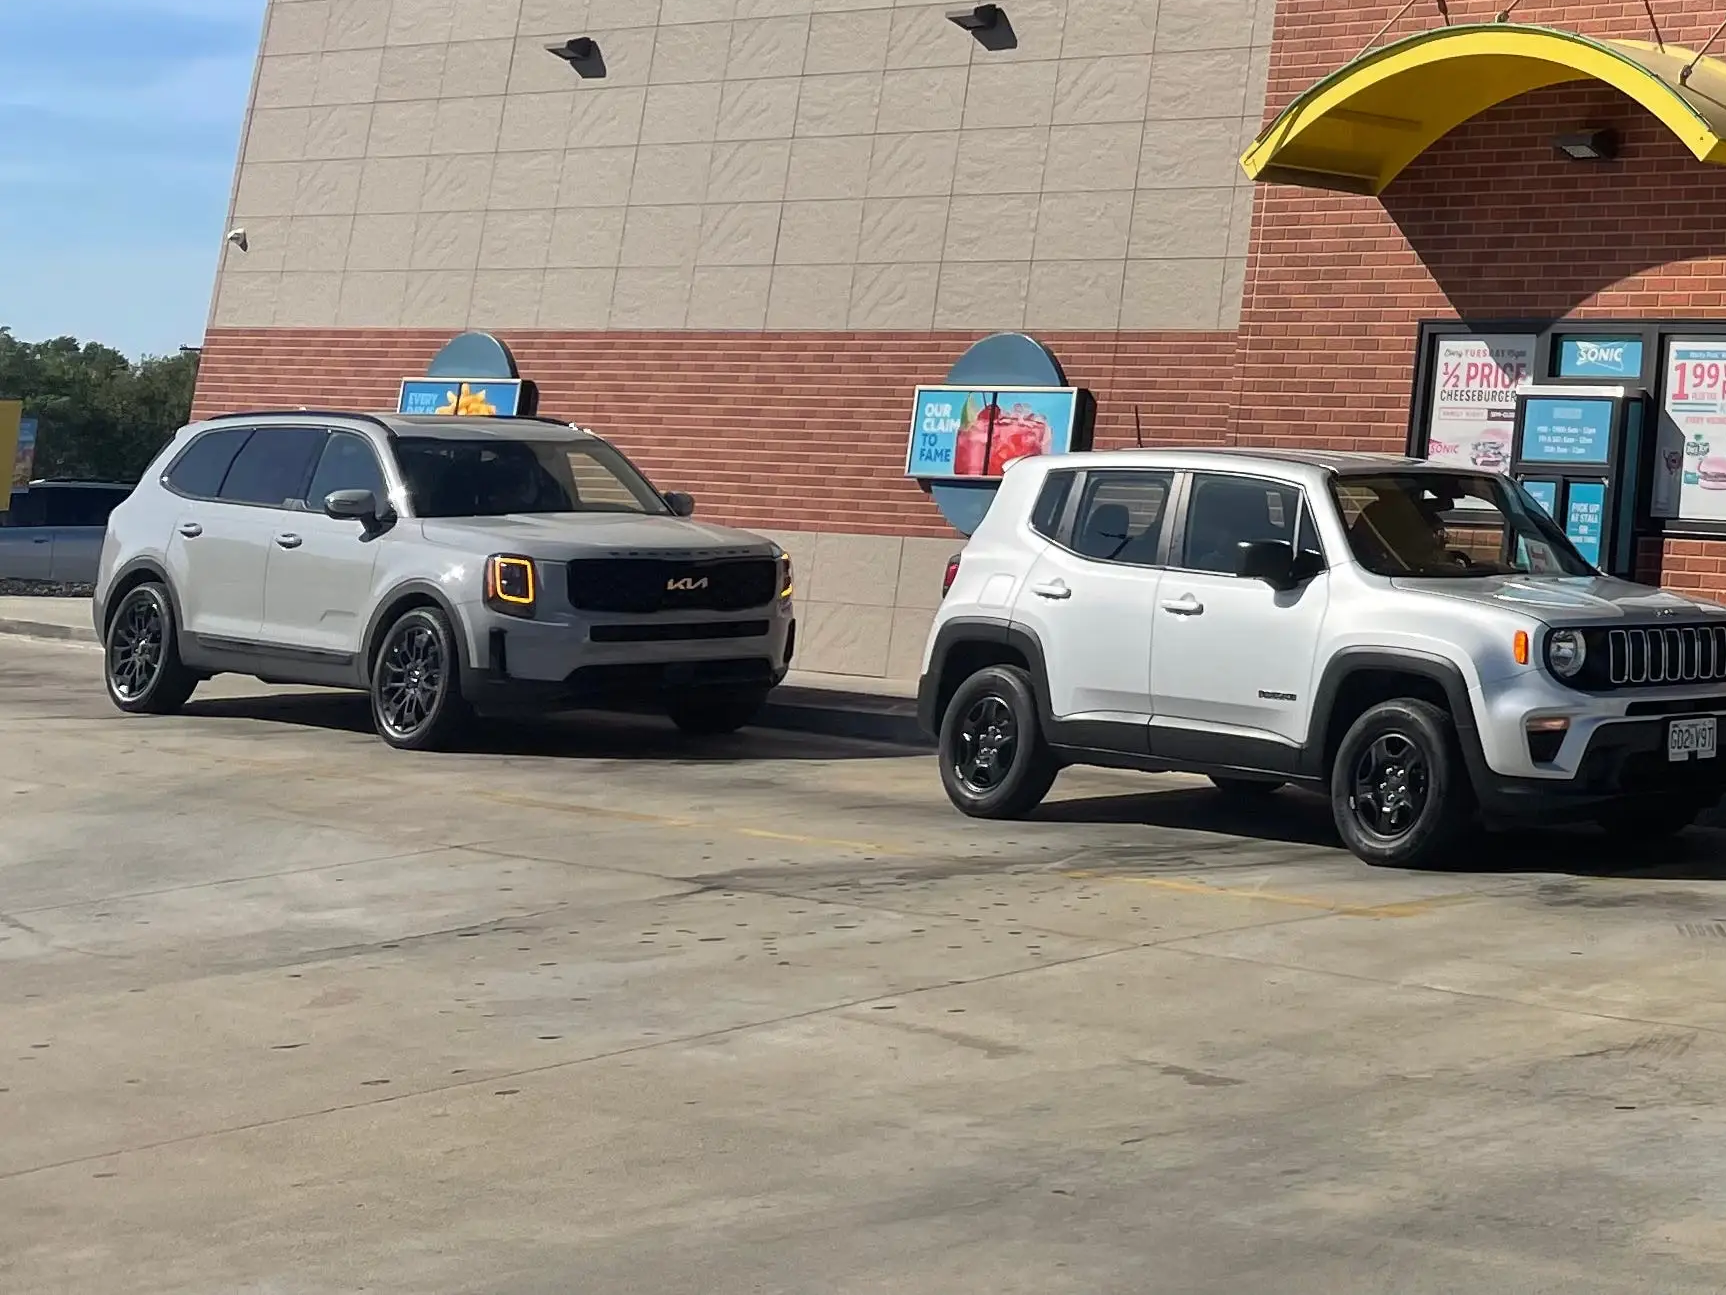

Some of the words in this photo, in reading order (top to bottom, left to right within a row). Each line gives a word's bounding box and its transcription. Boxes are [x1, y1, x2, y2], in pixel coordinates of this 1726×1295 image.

[1579, 347, 1624, 363] SONIC
[1465, 362, 1527, 389] PRICE
[408, 392, 440, 406] EVERY
[925, 403, 953, 418] OUR
[923, 418, 961, 433] CLAIM
[921, 433, 938, 447] TO
[919, 449, 952, 463] FAME
[1429, 444, 1460, 455] SONIC
